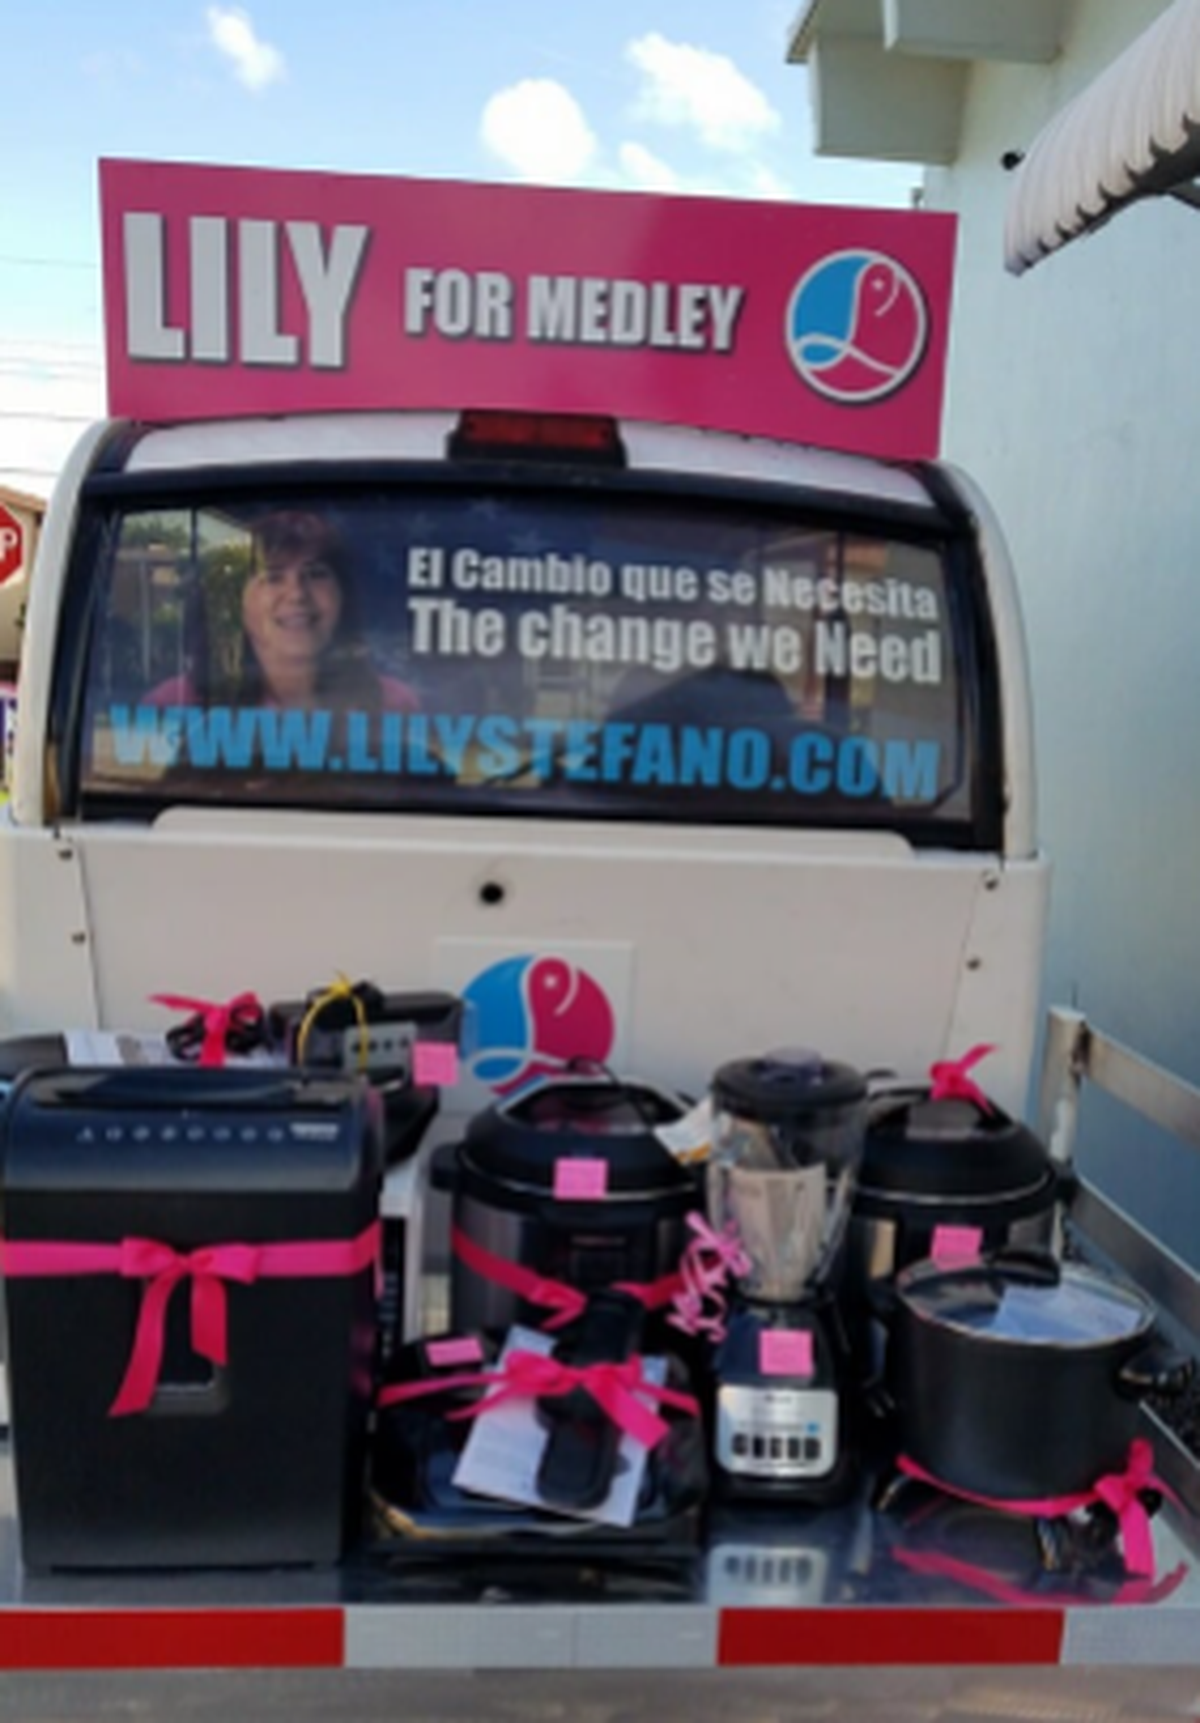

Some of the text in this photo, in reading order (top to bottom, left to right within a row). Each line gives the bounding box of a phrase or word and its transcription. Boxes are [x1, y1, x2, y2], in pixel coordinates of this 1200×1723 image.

[121, 211, 744, 369] LILY FOR MEDLEY
[407, 547, 940, 620] El Cambio que se Necesita
[407, 596, 942, 684] The change we Need
[109, 704, 940, 802] WWW.LILYSTEFANO.COM
